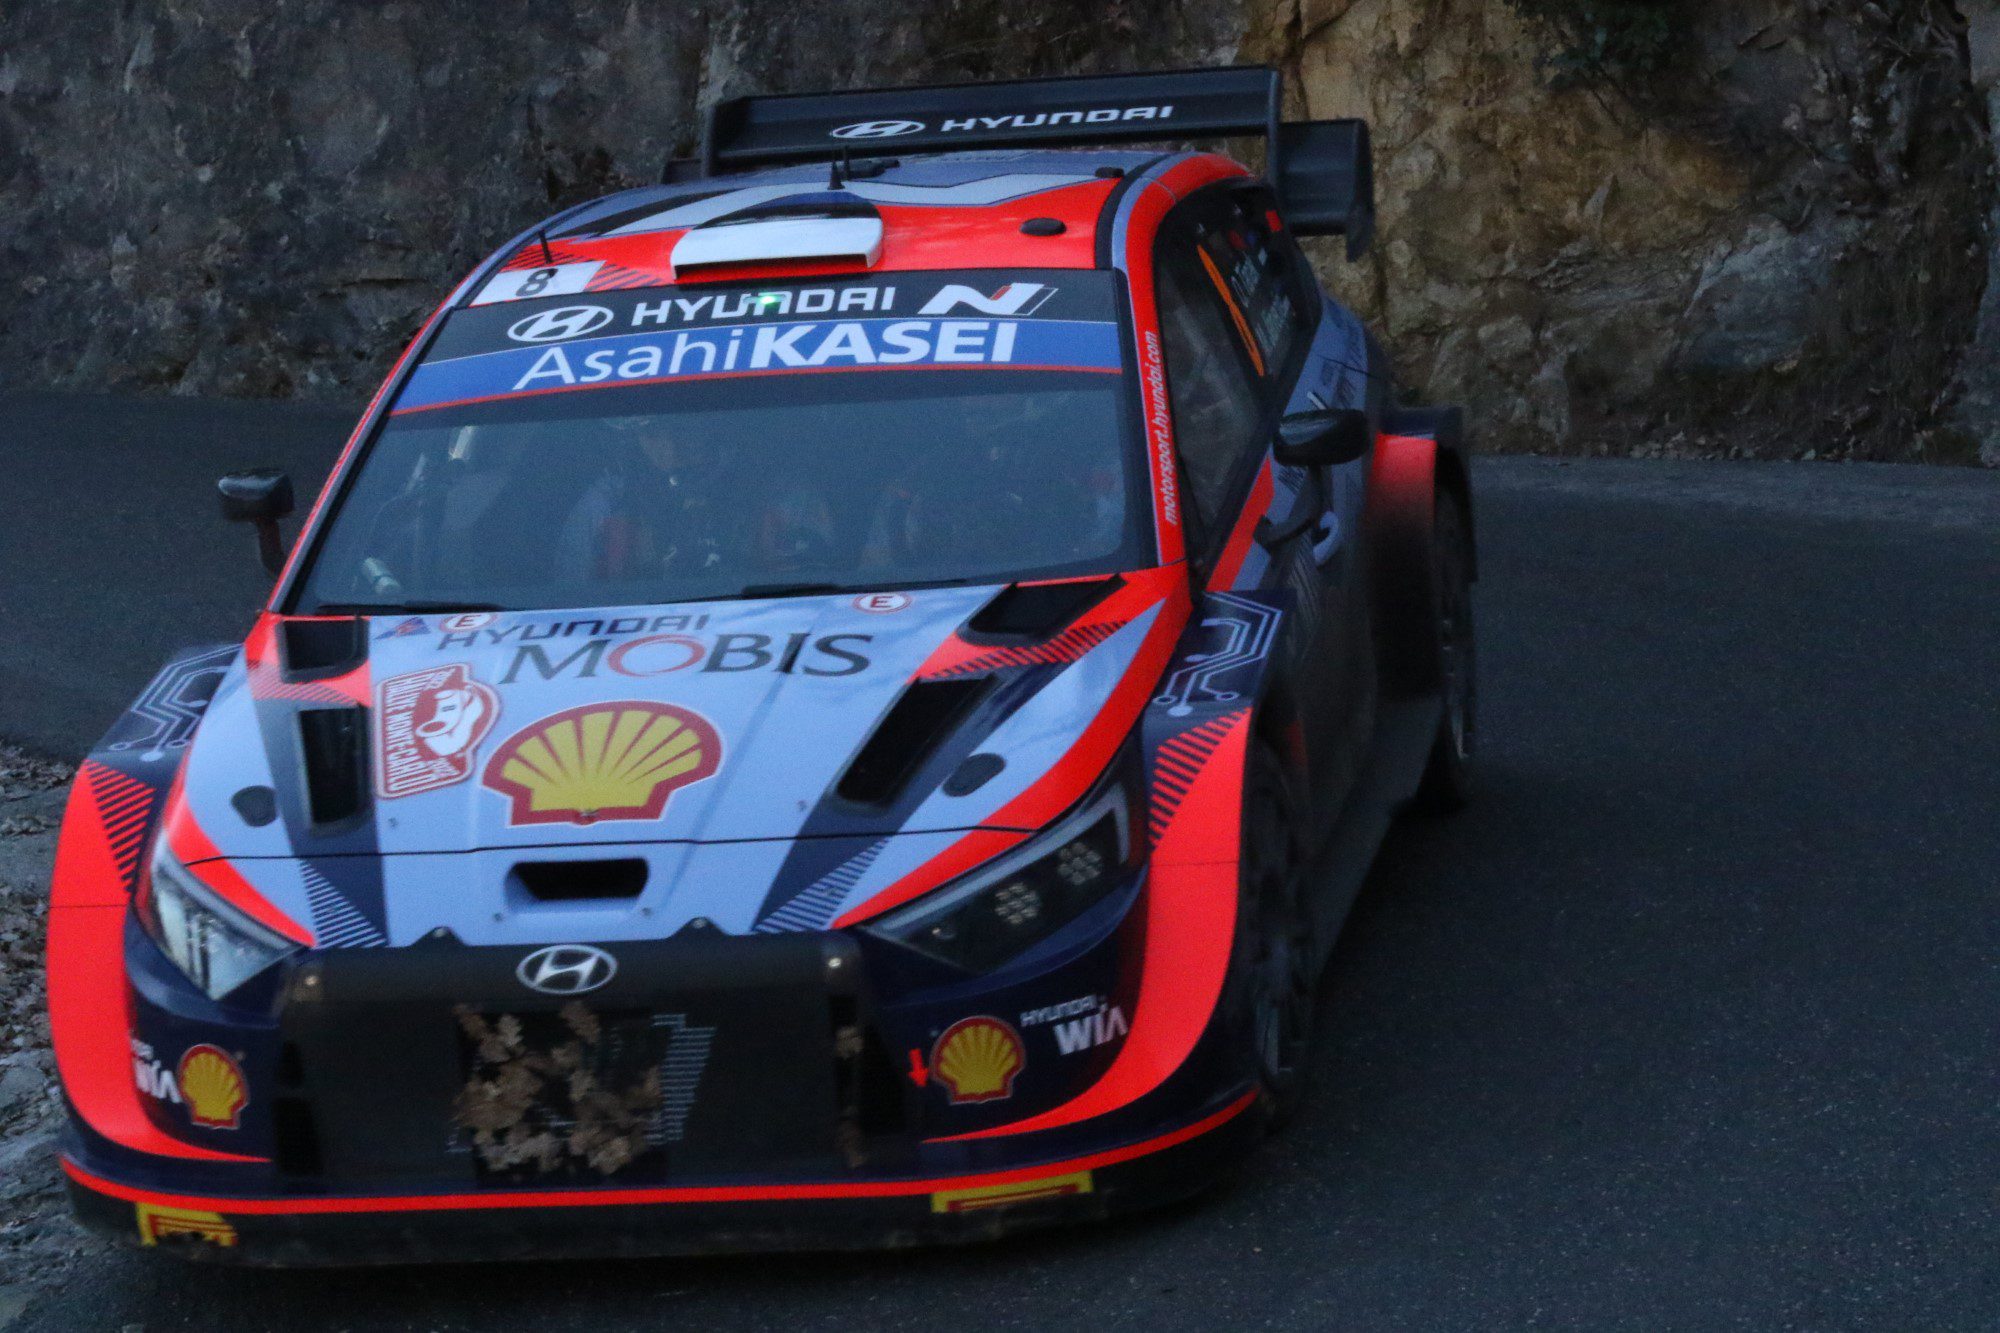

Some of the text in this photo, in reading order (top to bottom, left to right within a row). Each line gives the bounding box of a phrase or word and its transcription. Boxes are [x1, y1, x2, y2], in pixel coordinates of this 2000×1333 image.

[940, 105, 1174, 132] HYUNDAI
[515, 270, 558, 297] 8
[631, 286, 895, 325] HYUNDAI
[1143, 331, 1180, 526] motorsport.hyundai.com
[437, 614, 710, 651] HYUNDAI
[498, 633, 874, 684] MOBIS
[1053, 1003, 1129, 1056] WIA
